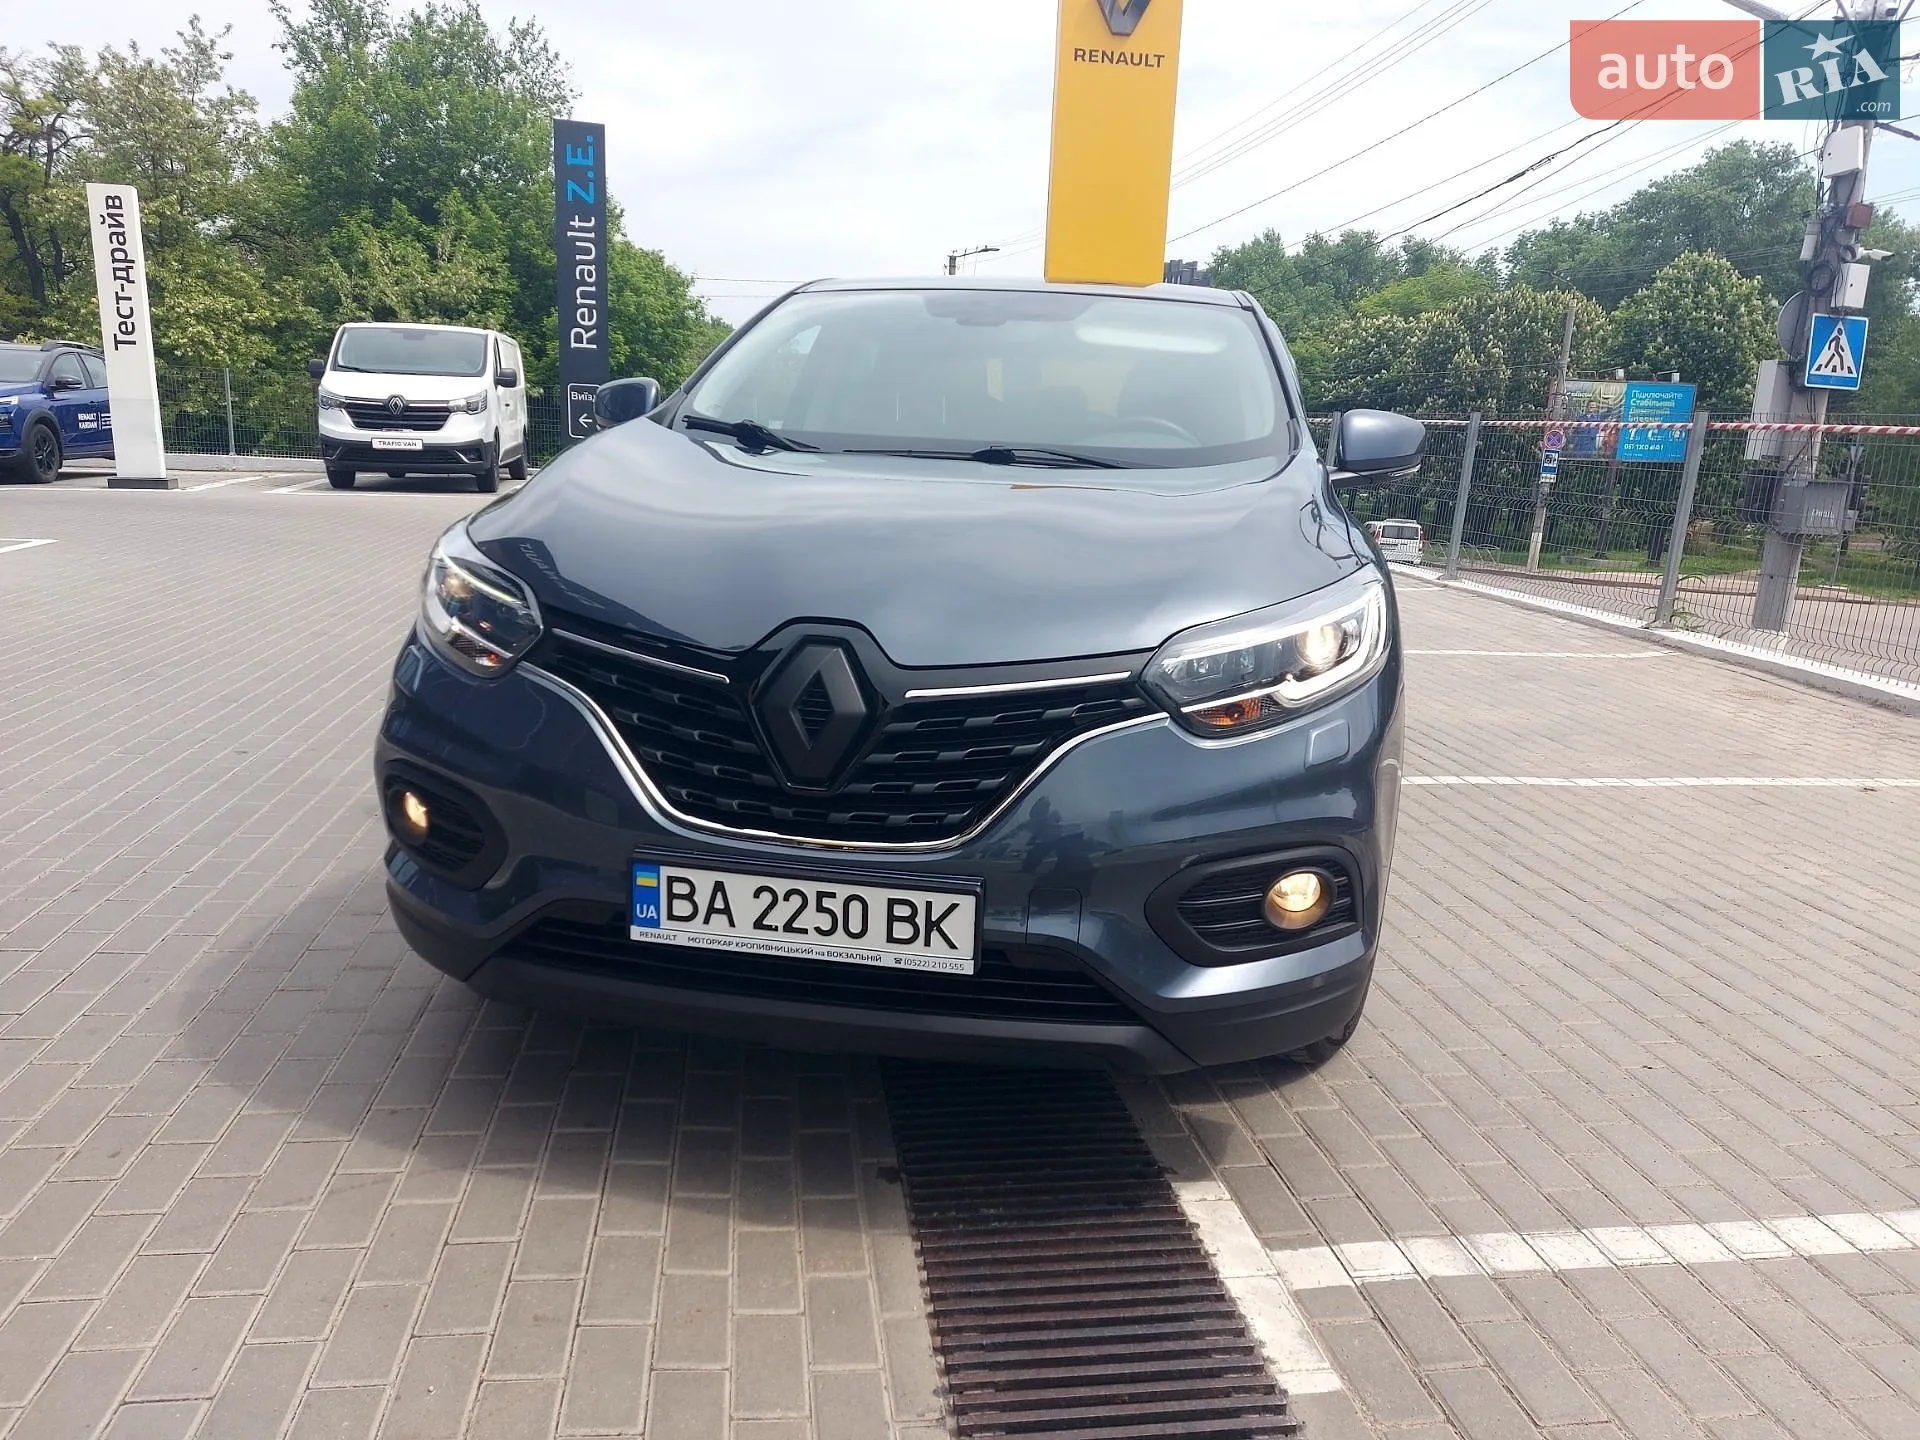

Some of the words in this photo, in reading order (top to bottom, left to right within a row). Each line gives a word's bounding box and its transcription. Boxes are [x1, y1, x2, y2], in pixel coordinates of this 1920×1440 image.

[1073, 47, 1165, 68] RENAULT
[566, 134, 594, 204] Z.E.
[100, 194, 136, 351] Тест-драйв
[567, 214, 597, 349] Renault
[571, 391, 595, 401] Виїз
[636, 904, 658, 919] UA
[666, 875, 736, 928] BA
[753, 885, 869, 940] 2250
[886, 897, 961, 950] BK
[639, 931, 678, 942] RENAULT
[687, 936, 734, 947] МОТОРКАР
[735, 942, 814, 956] КРОПИВНИЦЬКИЙ
[826, 951, 882, 963] ВОКЗАЛЬНІЙ
[903, 958, 930, 968] (0522)
[931, 961, 948, 969] 210
[949, 963, 965, 971] 555
